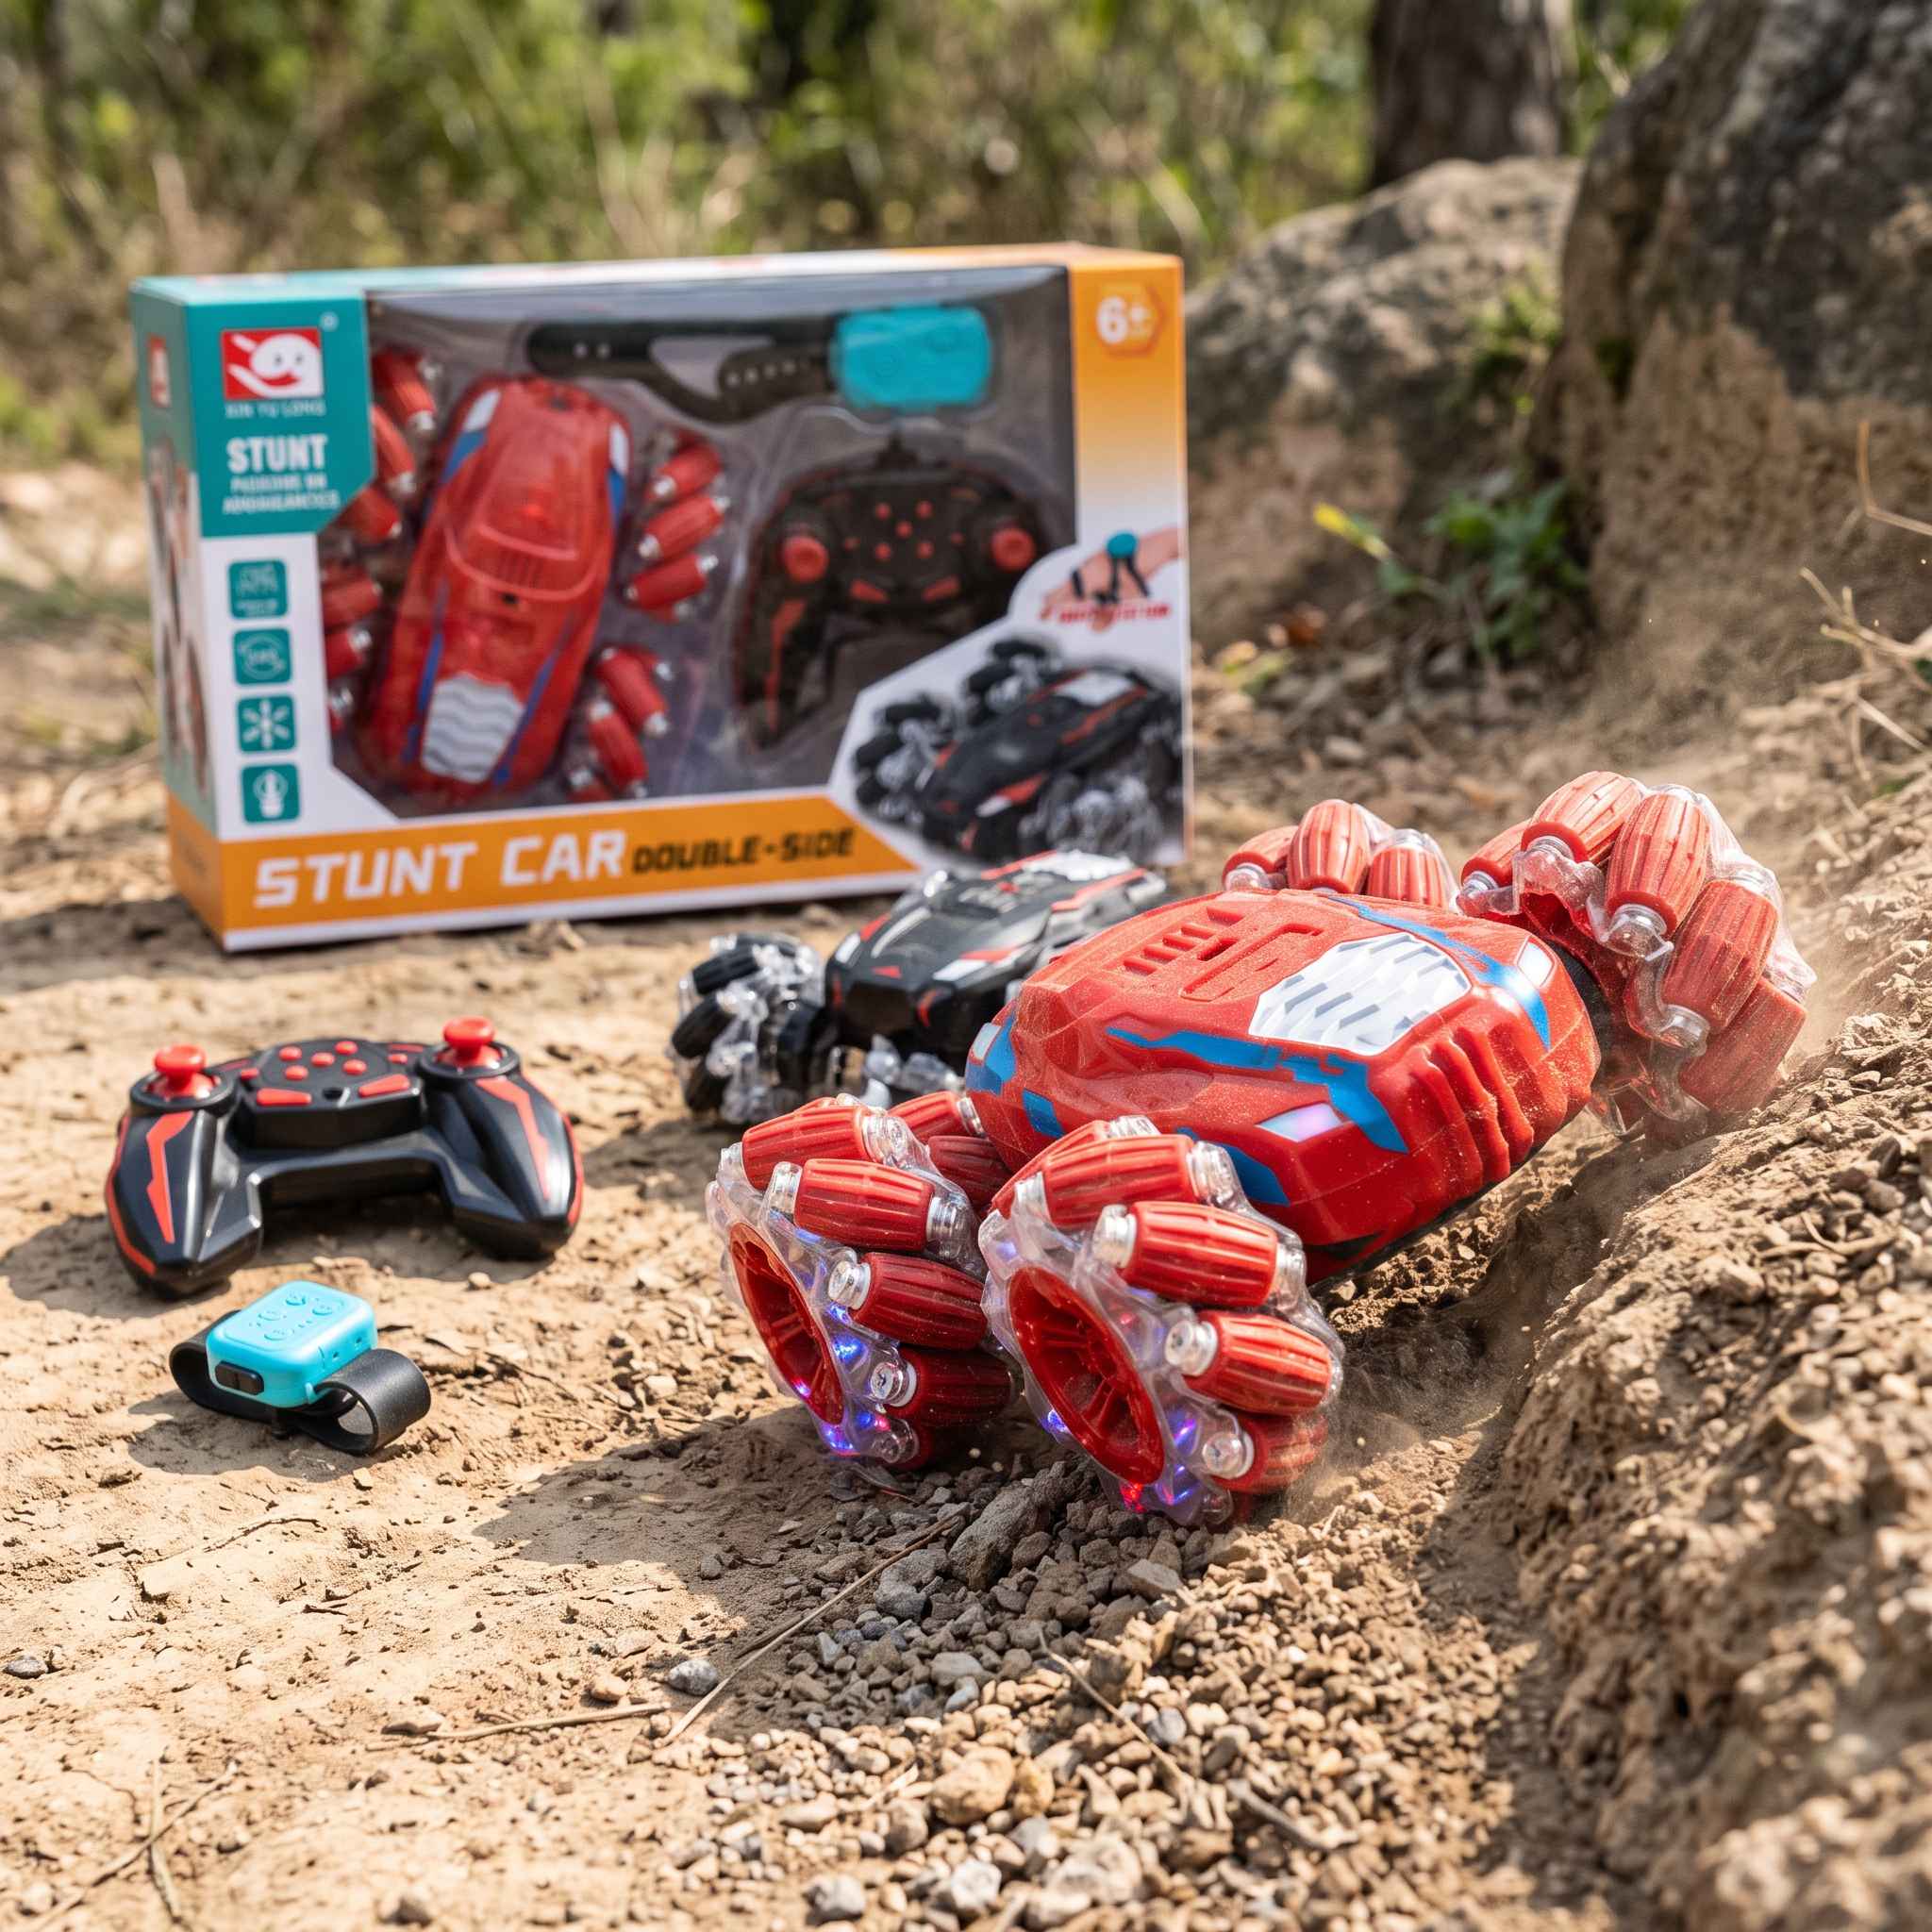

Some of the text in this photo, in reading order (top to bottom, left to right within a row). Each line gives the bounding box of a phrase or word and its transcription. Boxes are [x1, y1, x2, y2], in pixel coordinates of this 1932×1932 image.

[1097, 295, 1151, 343] 6+
[226, 434, 327, 473] STUNT
[253, 841, 479, 908] STUNT
[500, 829, 626, 887] CAR
[632, 827, 854, 874] DOUBLE-SIDE
